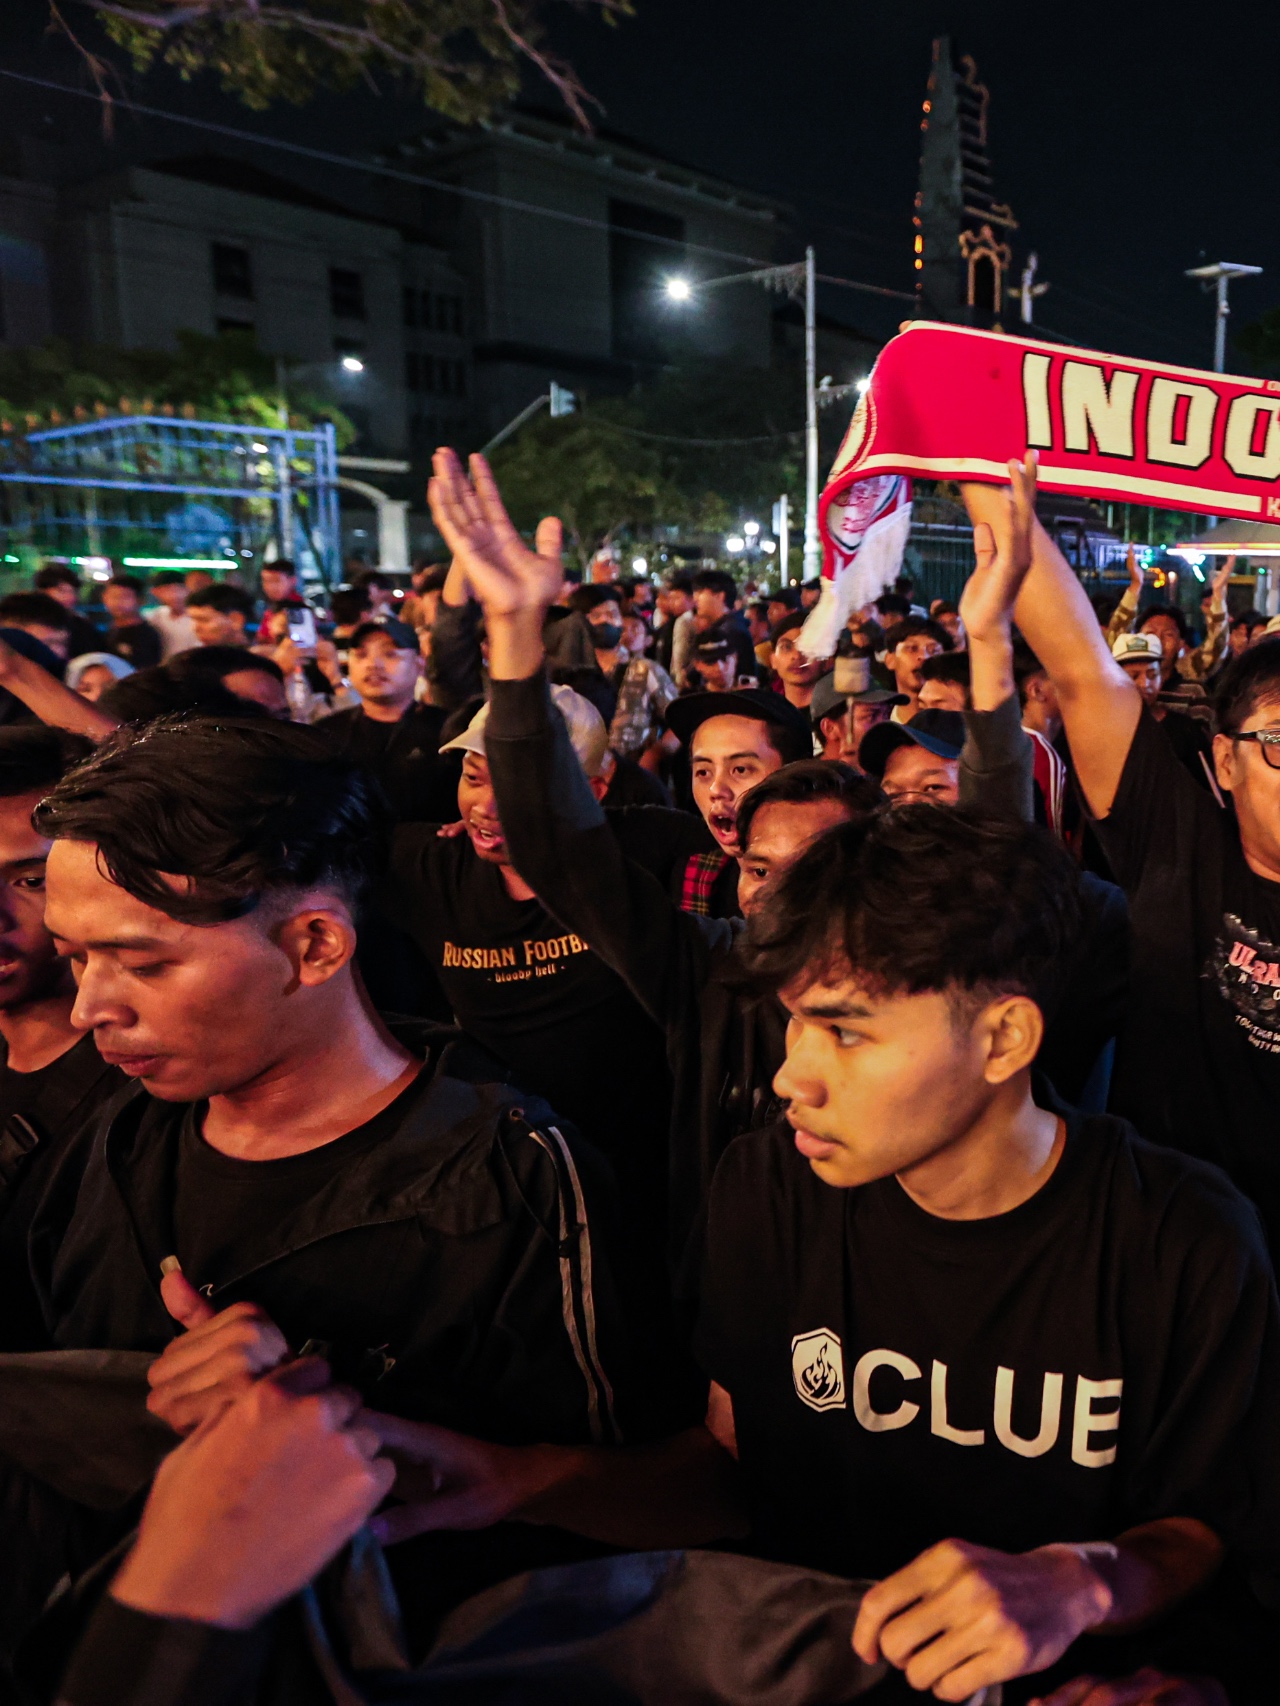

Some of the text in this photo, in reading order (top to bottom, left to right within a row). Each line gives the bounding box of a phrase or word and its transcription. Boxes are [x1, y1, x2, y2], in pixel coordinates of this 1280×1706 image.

[442, 933, 589, 969] RUSSIAN FOOTB
[853, 1348, 1123, 1468] CLUE
